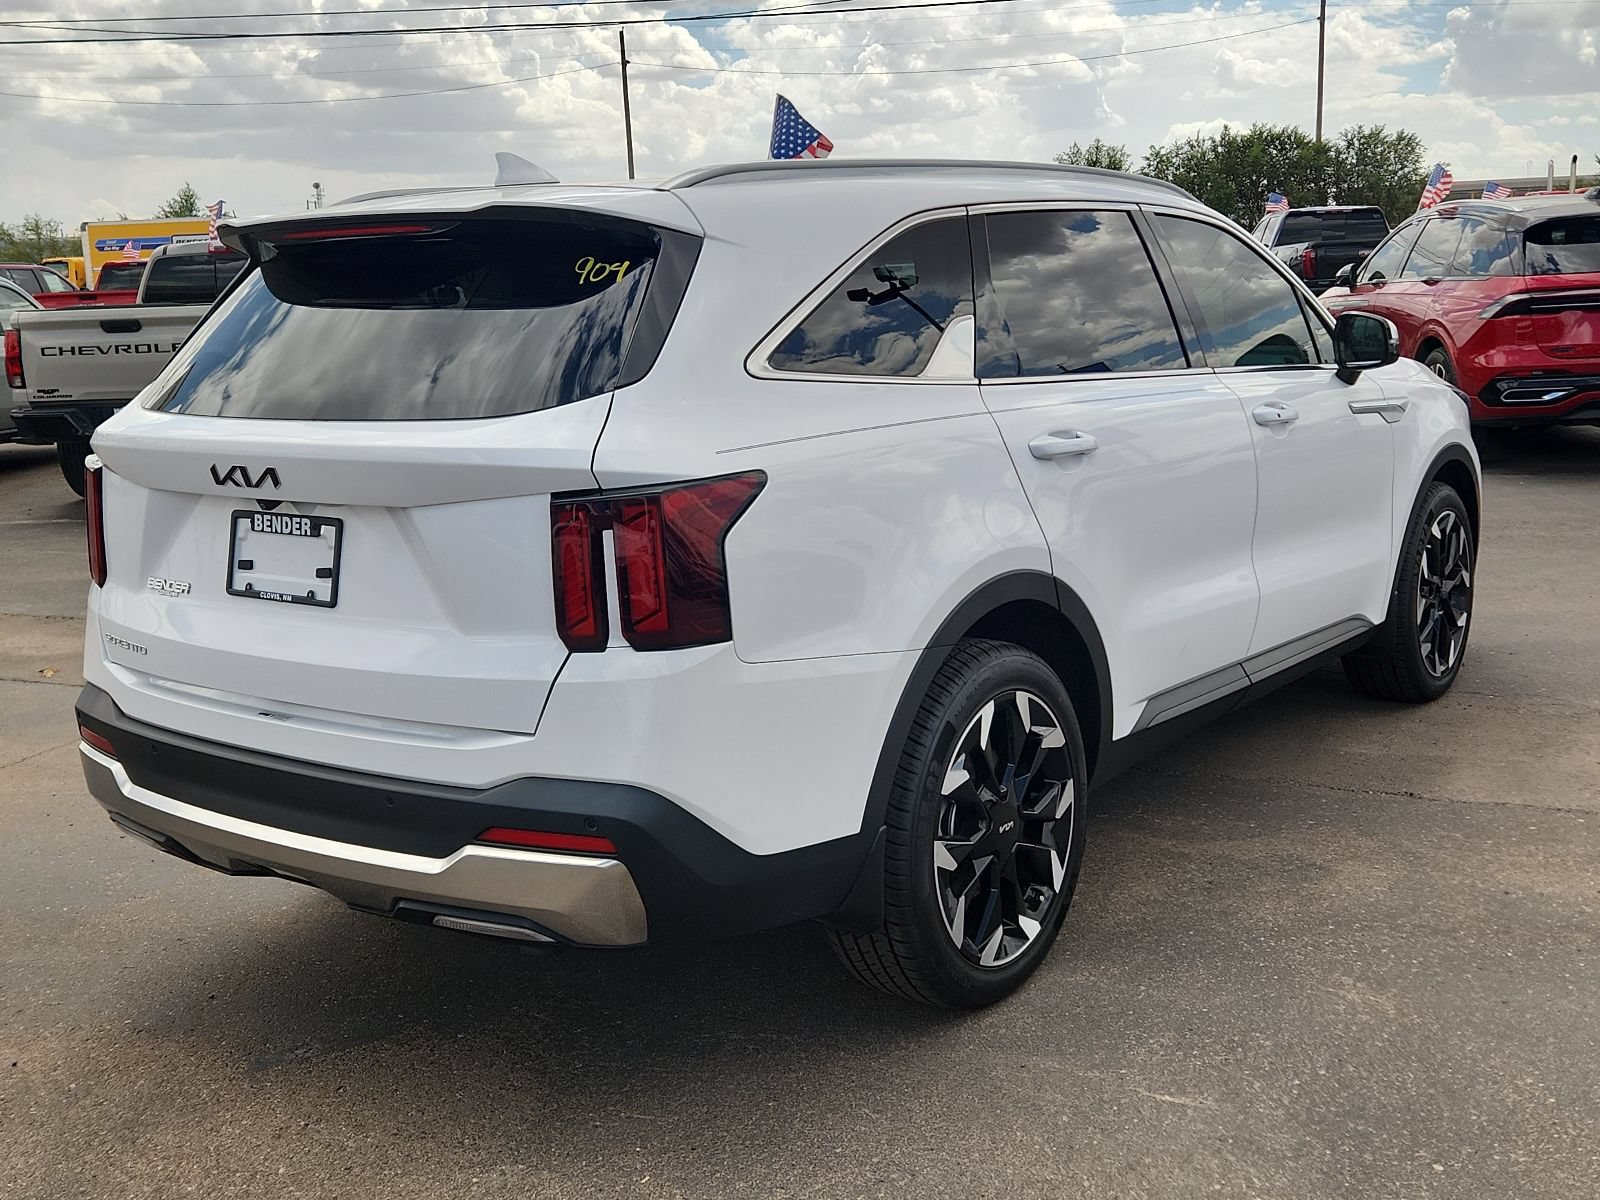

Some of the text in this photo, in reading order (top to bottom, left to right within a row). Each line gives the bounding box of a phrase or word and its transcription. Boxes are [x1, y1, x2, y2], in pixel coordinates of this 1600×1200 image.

[209, 463, 282, 490] KIA
[253, 513, 311, 536] BENDER
[147, 576, 192, 595] BENDER
[259, 591, 292, 602] CLOVIS, NM
